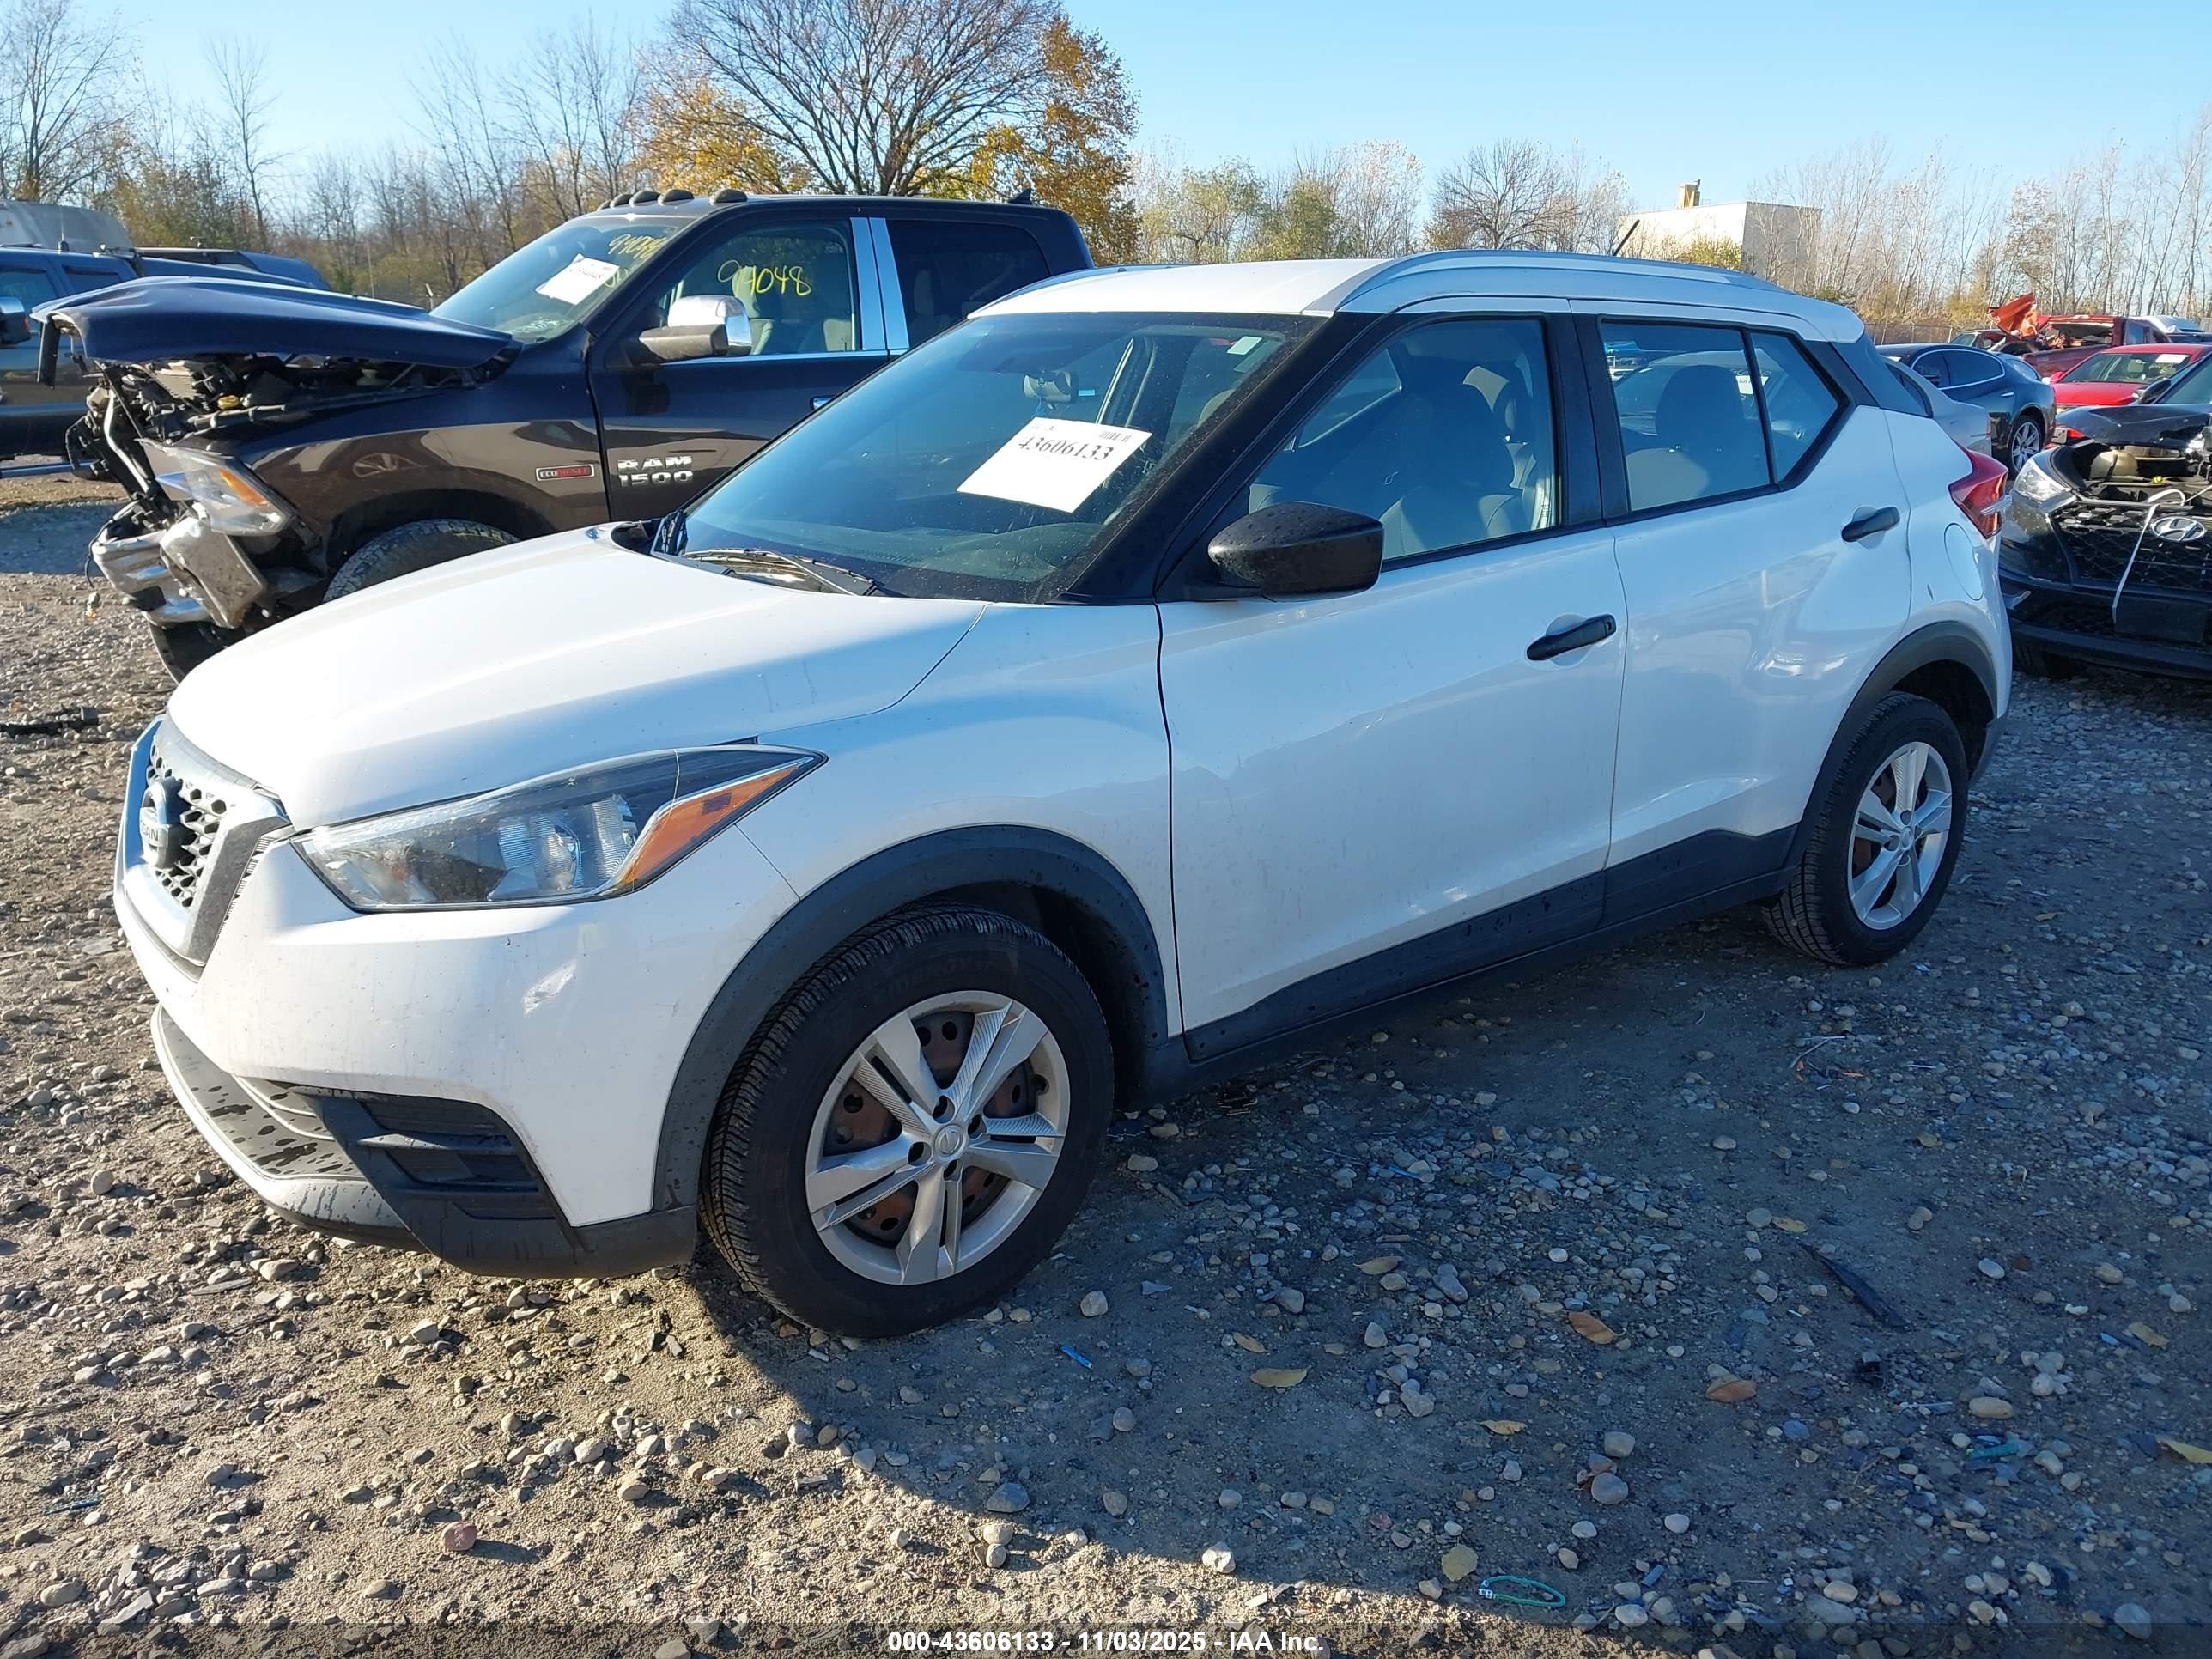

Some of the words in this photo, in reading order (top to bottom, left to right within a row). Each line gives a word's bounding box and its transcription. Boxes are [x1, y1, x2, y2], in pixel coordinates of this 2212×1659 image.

[718, 259, 811, 296] 94048
[1018, 436, 1114, 460] 43606133
[617, 456, 692, 471] RAM
[618, 471, 693, 488] 1500
